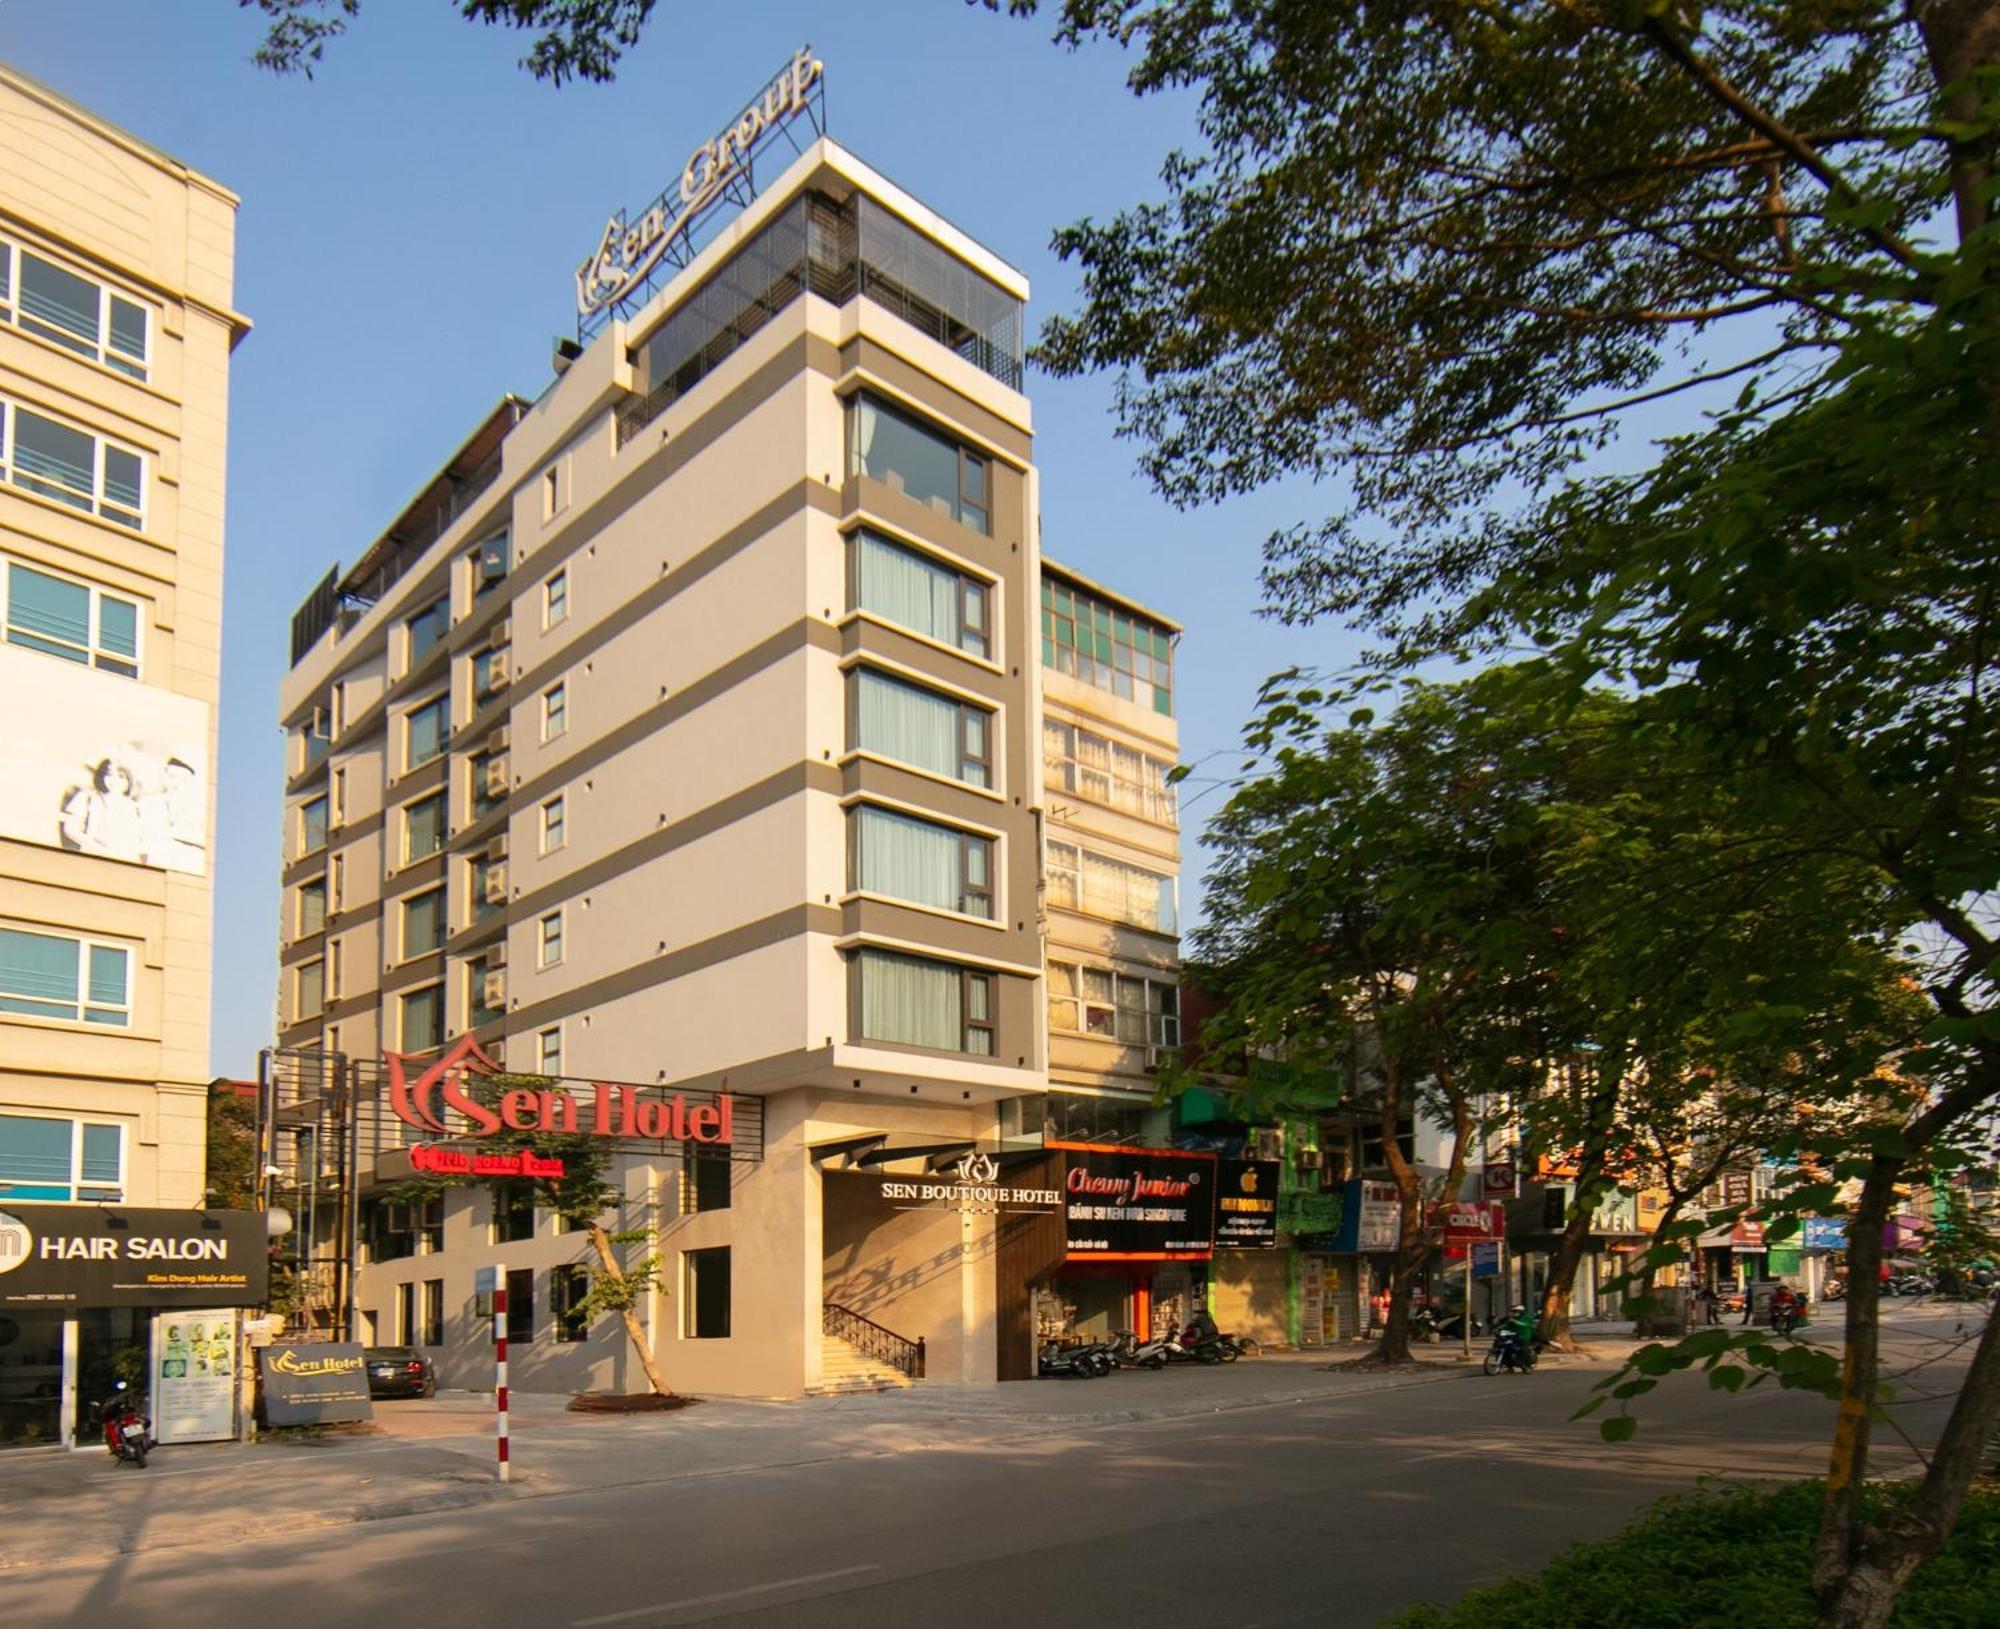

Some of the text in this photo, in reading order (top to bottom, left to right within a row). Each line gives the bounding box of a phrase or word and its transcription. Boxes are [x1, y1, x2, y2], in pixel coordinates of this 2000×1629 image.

[680, 54, 823, 203] Group
[436, 1050, 734, 1145] Sen Hotel
[881, 1183, 1063, 1205] SEN BOUTIQUE HOTEL
[1067, 1166, 1190, 1206] Chewy Junior
[40, 1236, 228, 1261] HAIR SALON
[322, 1356, 364, 1370] Hotel
